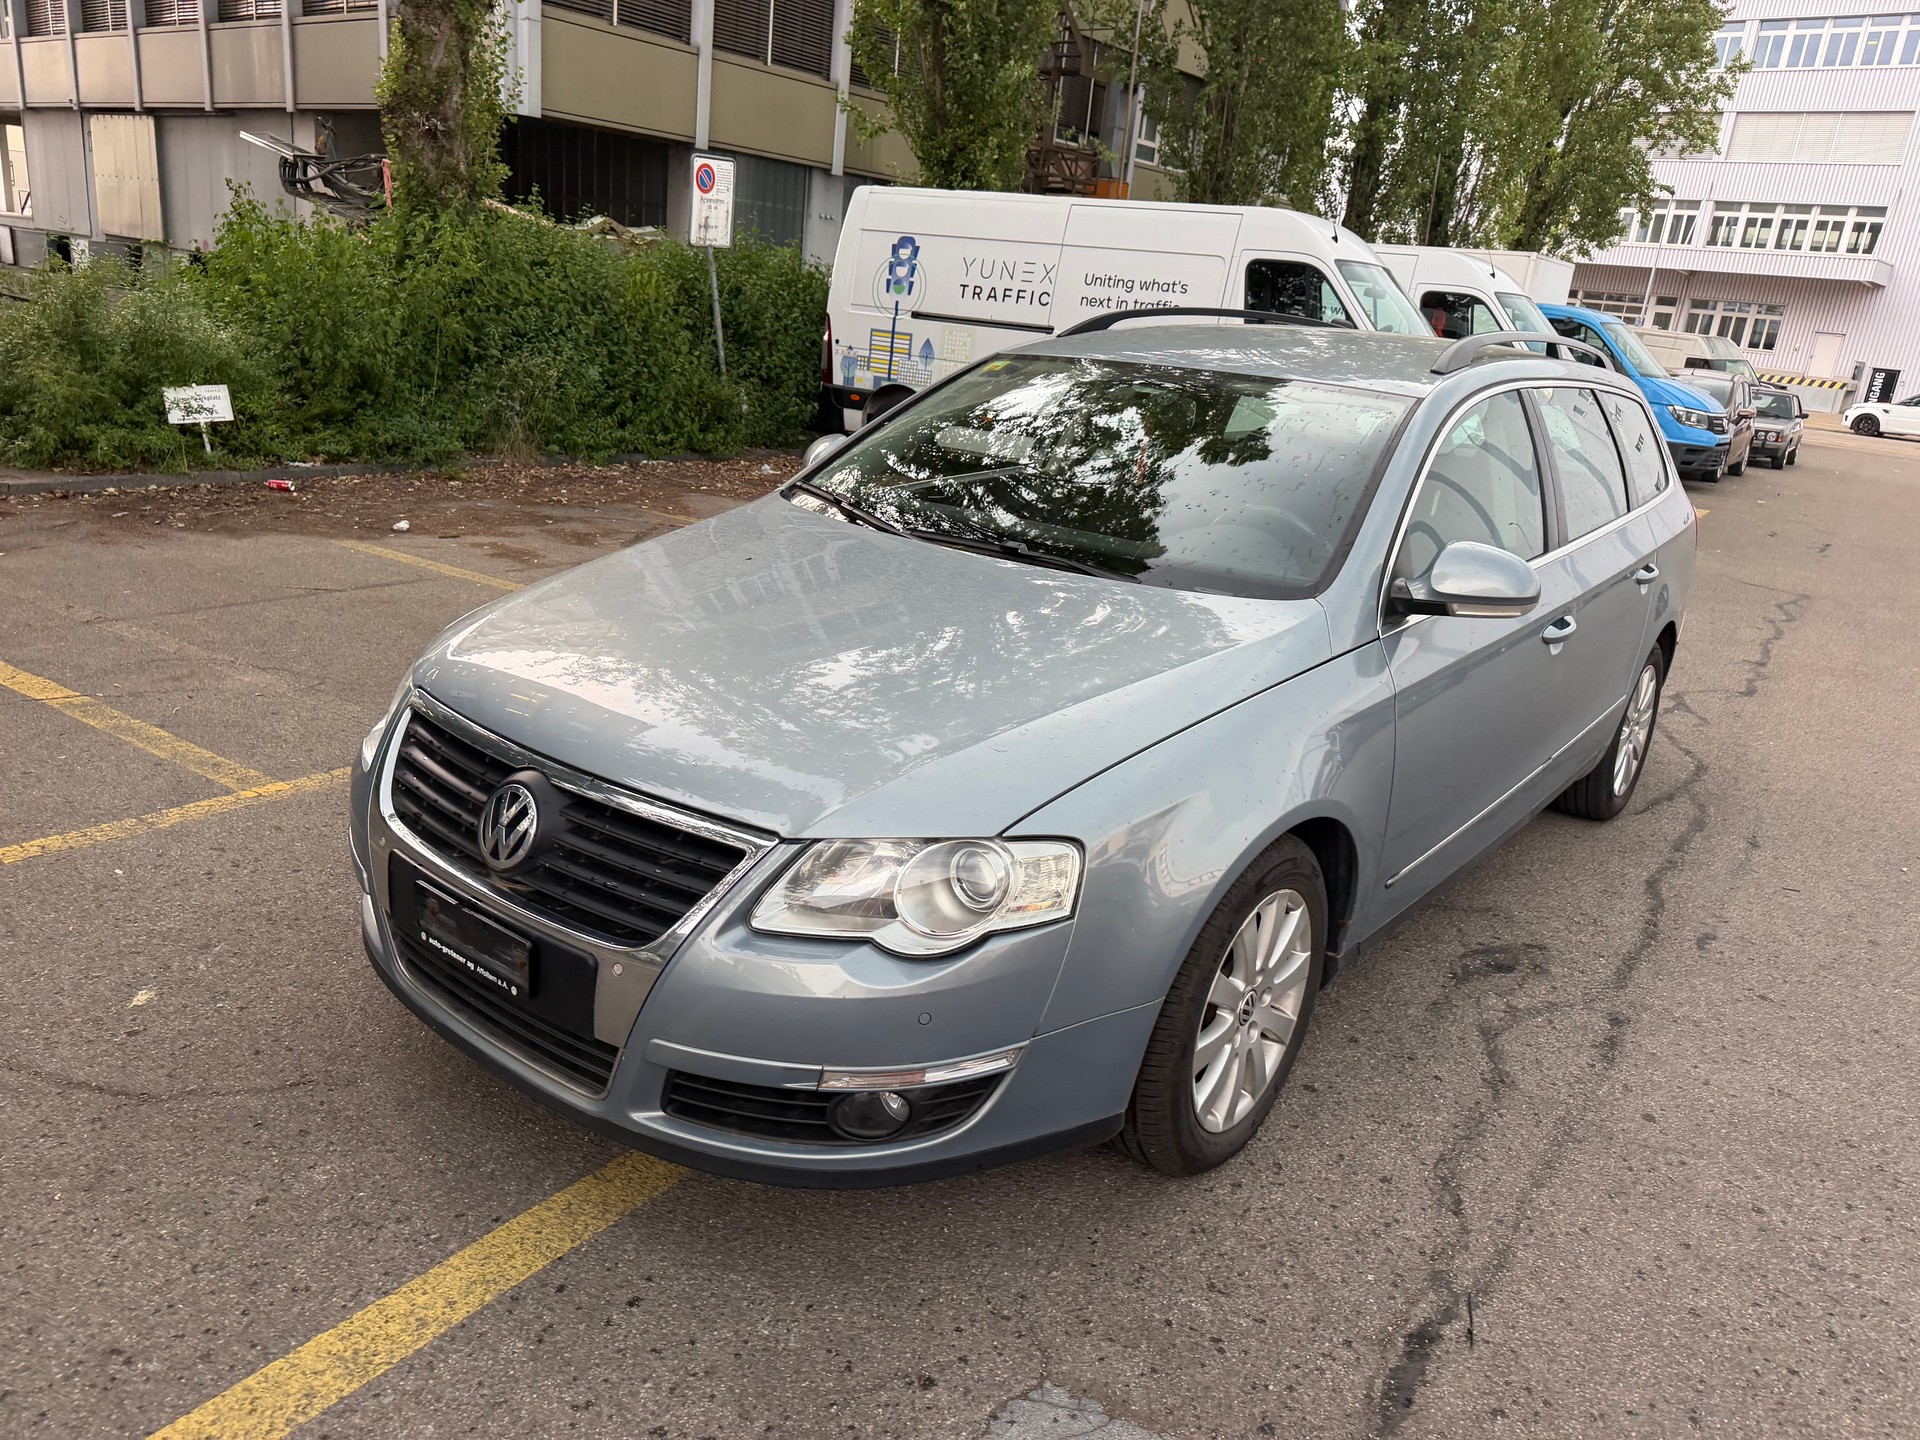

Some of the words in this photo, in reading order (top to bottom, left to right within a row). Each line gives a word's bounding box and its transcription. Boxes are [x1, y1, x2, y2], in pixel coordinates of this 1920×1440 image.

[962, 257, 1057, 285] YUNEX
[1084, 272, 1136, 294] Uniting
[1139, 278, 1189, 294] what's
[959, 283, 1052, 307] TRAFFIC
[1080, 296, 1113, 310] next
[1115, 296, 1129, 311] in
[1133, 298, 1181, 311] traffi
[466, 960, 475, 971] ag
